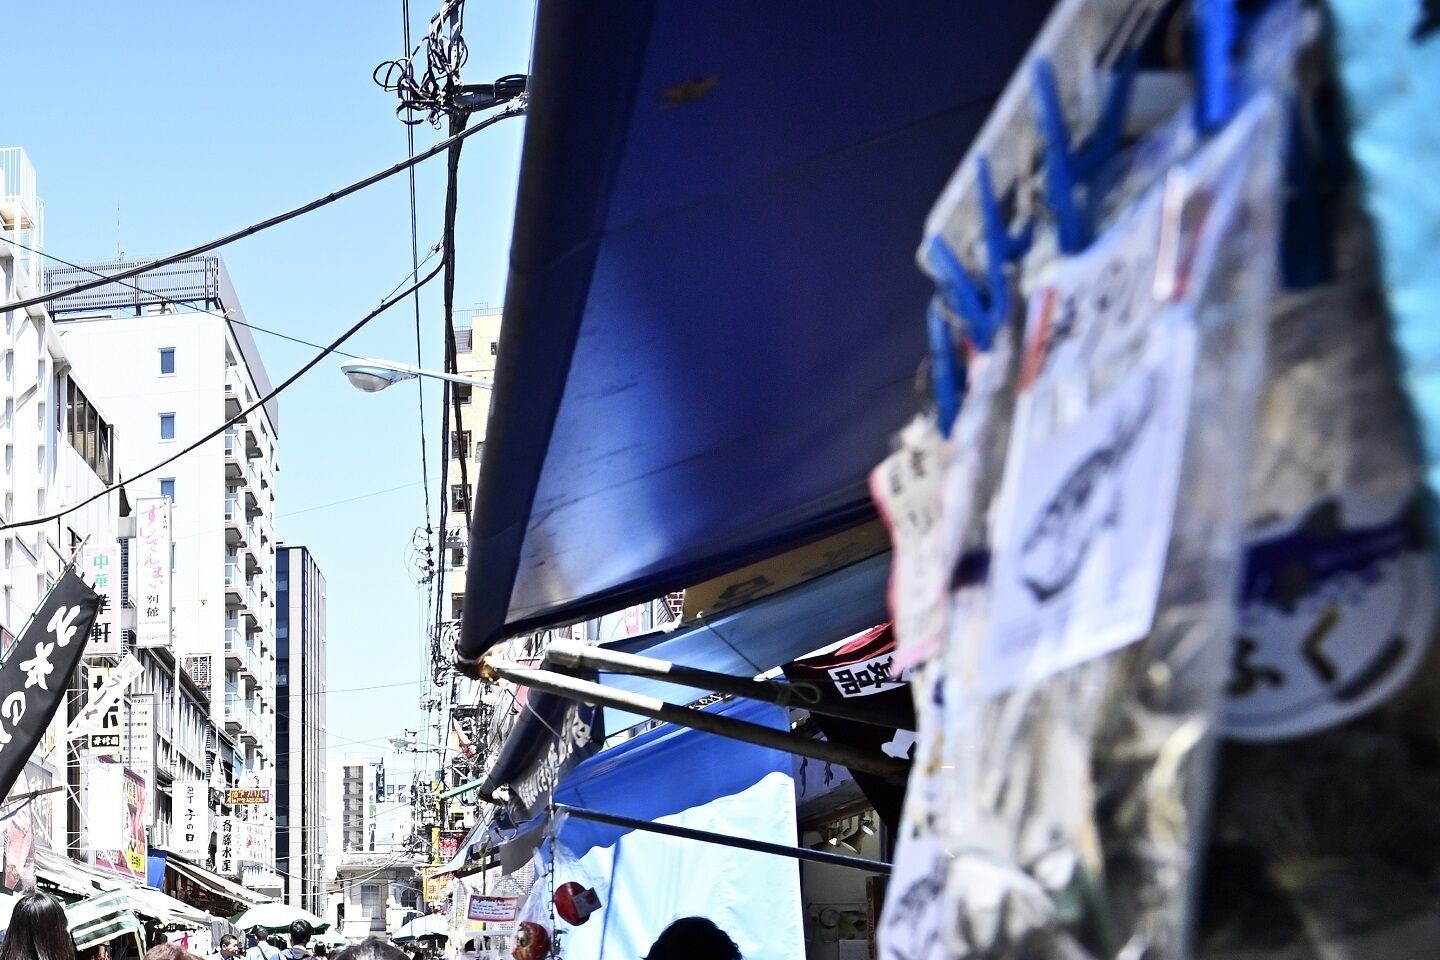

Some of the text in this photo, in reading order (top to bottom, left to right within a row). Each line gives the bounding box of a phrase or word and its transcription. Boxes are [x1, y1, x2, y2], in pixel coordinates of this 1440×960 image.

[146, 594, 160, 618] 別館
[184, 808, 196, 842] 子の日
